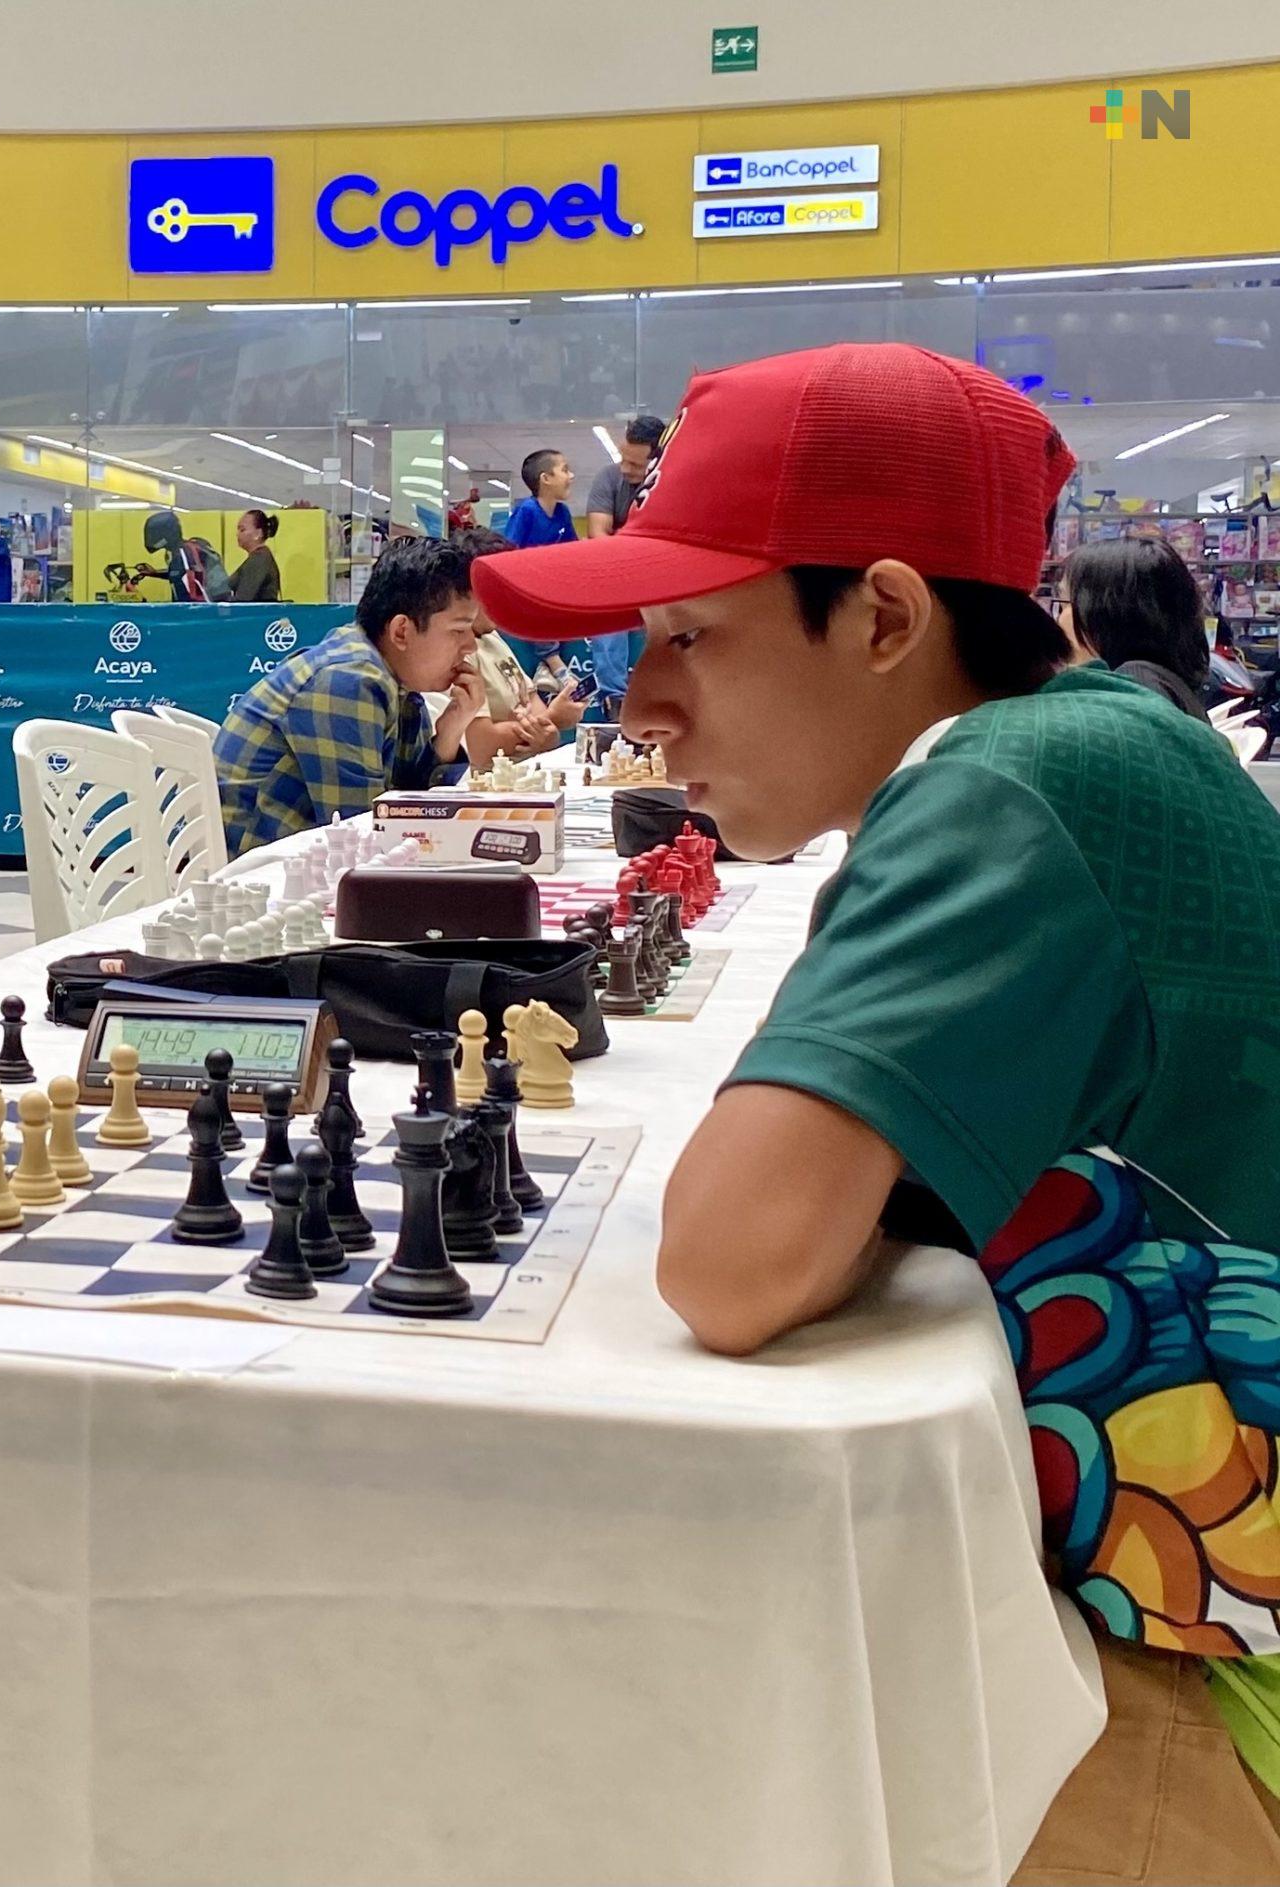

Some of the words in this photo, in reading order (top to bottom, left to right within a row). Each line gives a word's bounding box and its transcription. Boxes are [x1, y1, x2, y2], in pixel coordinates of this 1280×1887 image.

[746, 156, 857, 180] BanCoppel
[316, 163, 633, 268] Coppel
[736, 208, 781, 225] Afore
[793, 204, 858, 224] Coppel
[94, 656, 158, 678] Acaya.
